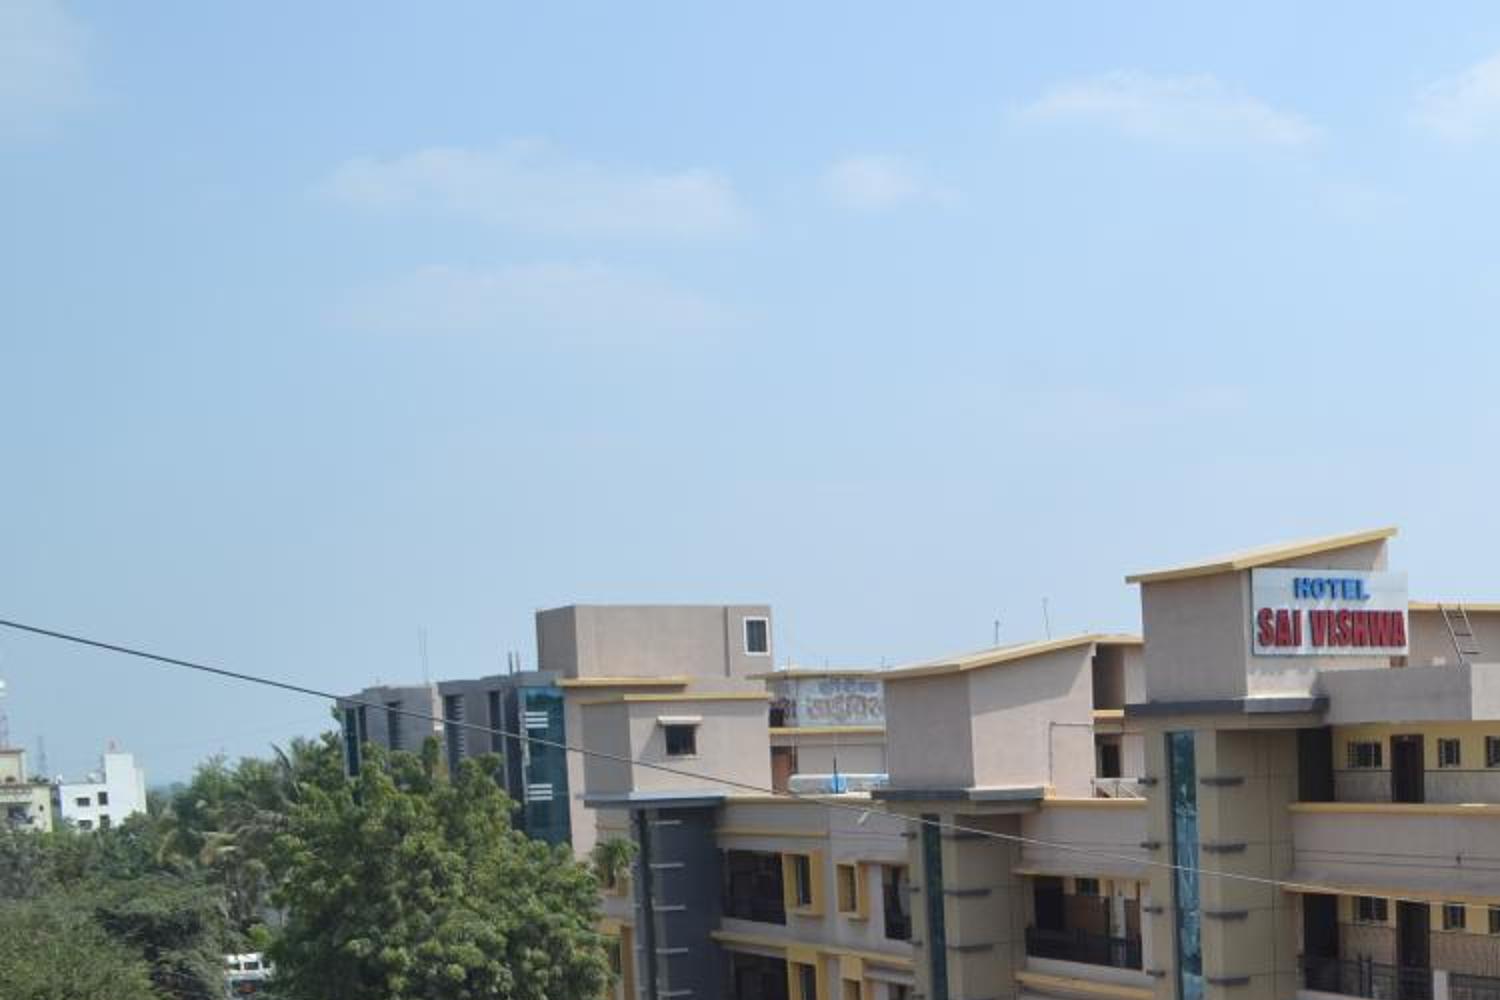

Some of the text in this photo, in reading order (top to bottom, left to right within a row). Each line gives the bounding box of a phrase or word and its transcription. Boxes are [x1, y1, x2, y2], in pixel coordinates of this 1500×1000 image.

[1294, 577, 1371, 601] HOTEL
[1257, 607, 1407, 648] SAI VISHWA
